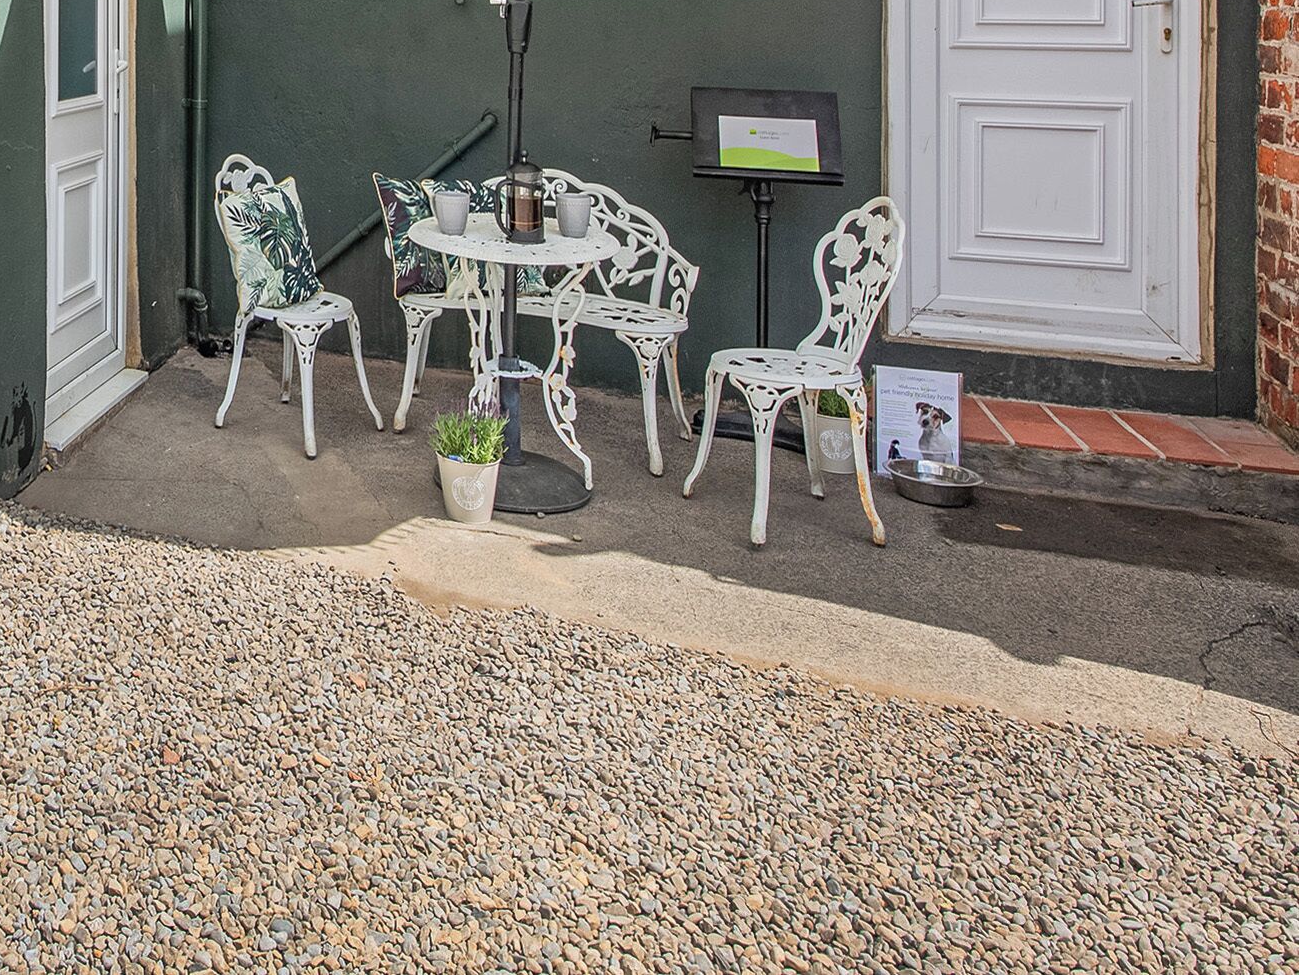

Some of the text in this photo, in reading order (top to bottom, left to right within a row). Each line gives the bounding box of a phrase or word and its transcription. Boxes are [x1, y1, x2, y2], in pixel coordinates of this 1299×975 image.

[891, 389, 913, 398] friendly
[914, 391, 937, 400] holiday
[936, 393, 955, 402] home
